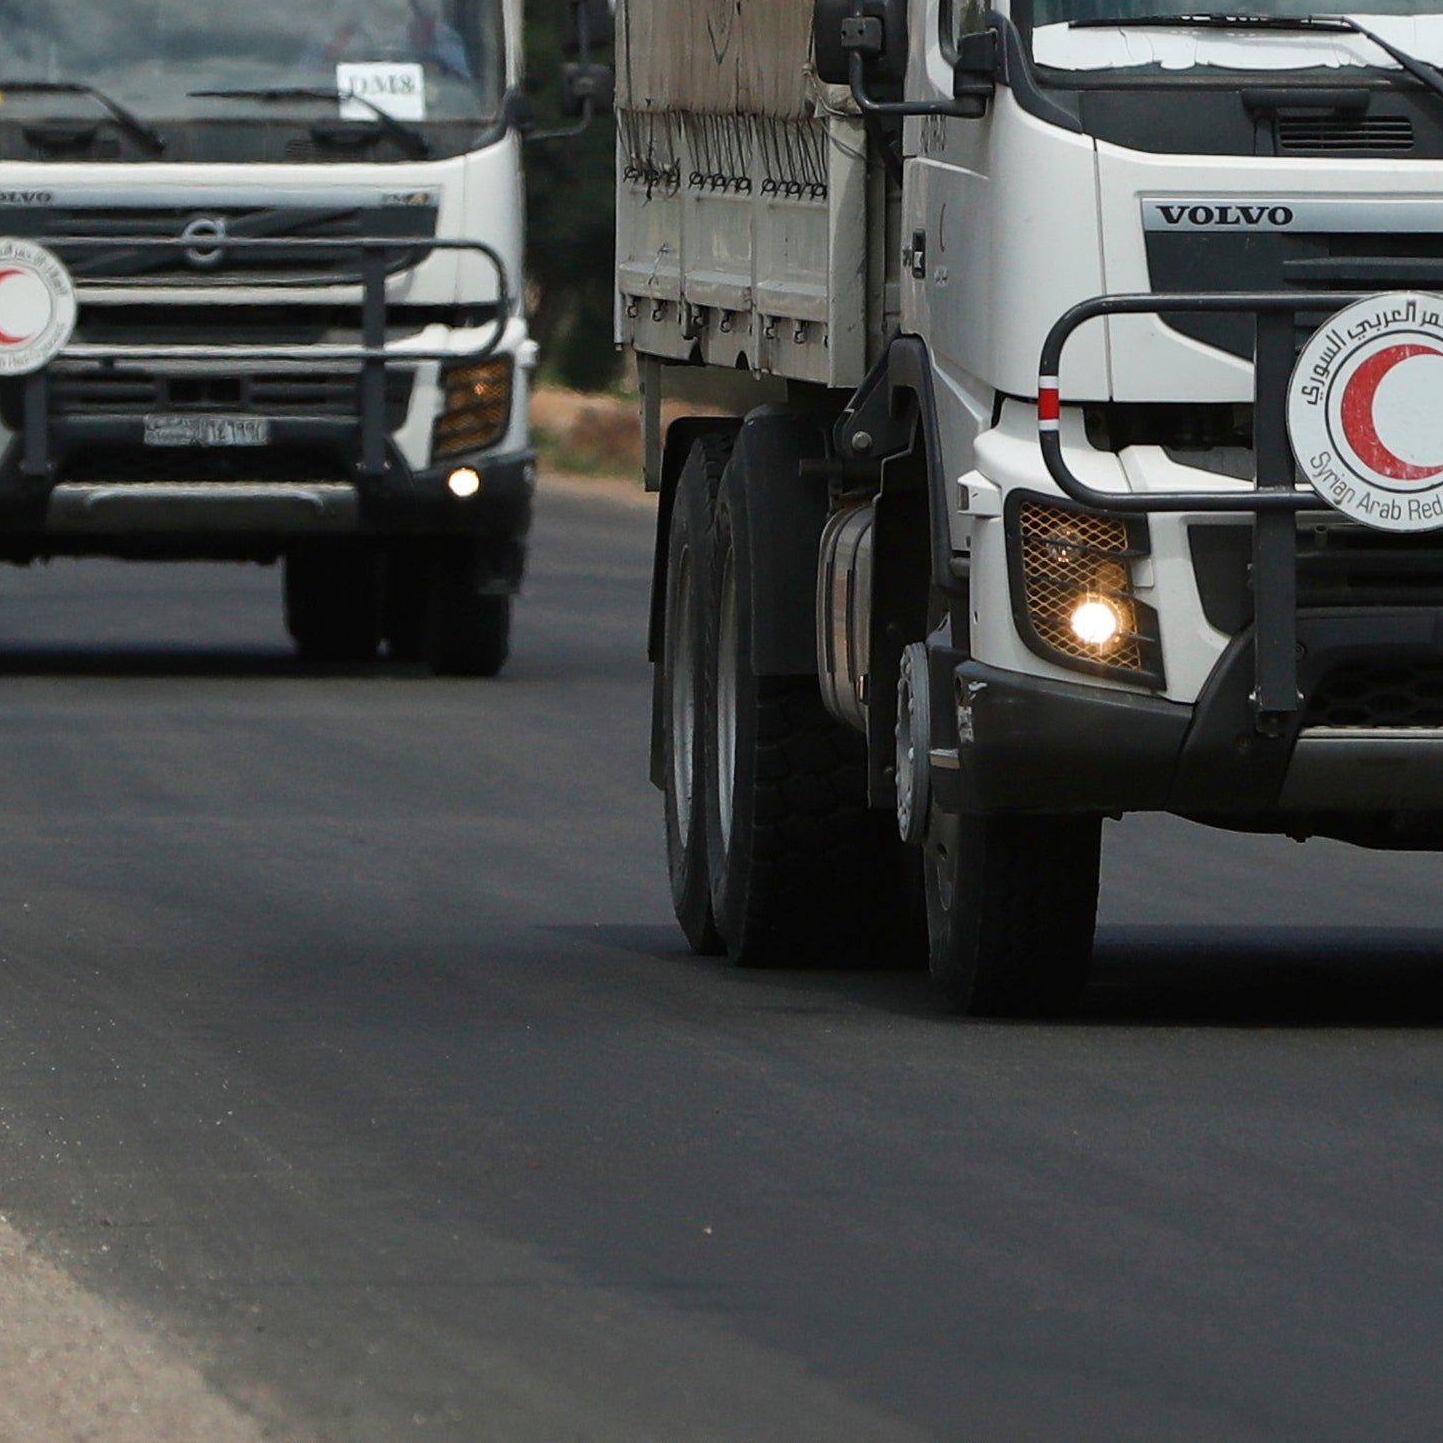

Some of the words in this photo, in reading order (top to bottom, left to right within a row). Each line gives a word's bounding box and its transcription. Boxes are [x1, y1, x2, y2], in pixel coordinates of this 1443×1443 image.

[1155, 205, 1294, 226] VOLVO
[1347, 299, 1417, 341] العربي
[1301, 328, 1348, 406] السوري
[1309, 450, 1356, 505] Syrian
[1357, 491, 1402, 521] Arab
[1407, 493, 1443, 521] Red
